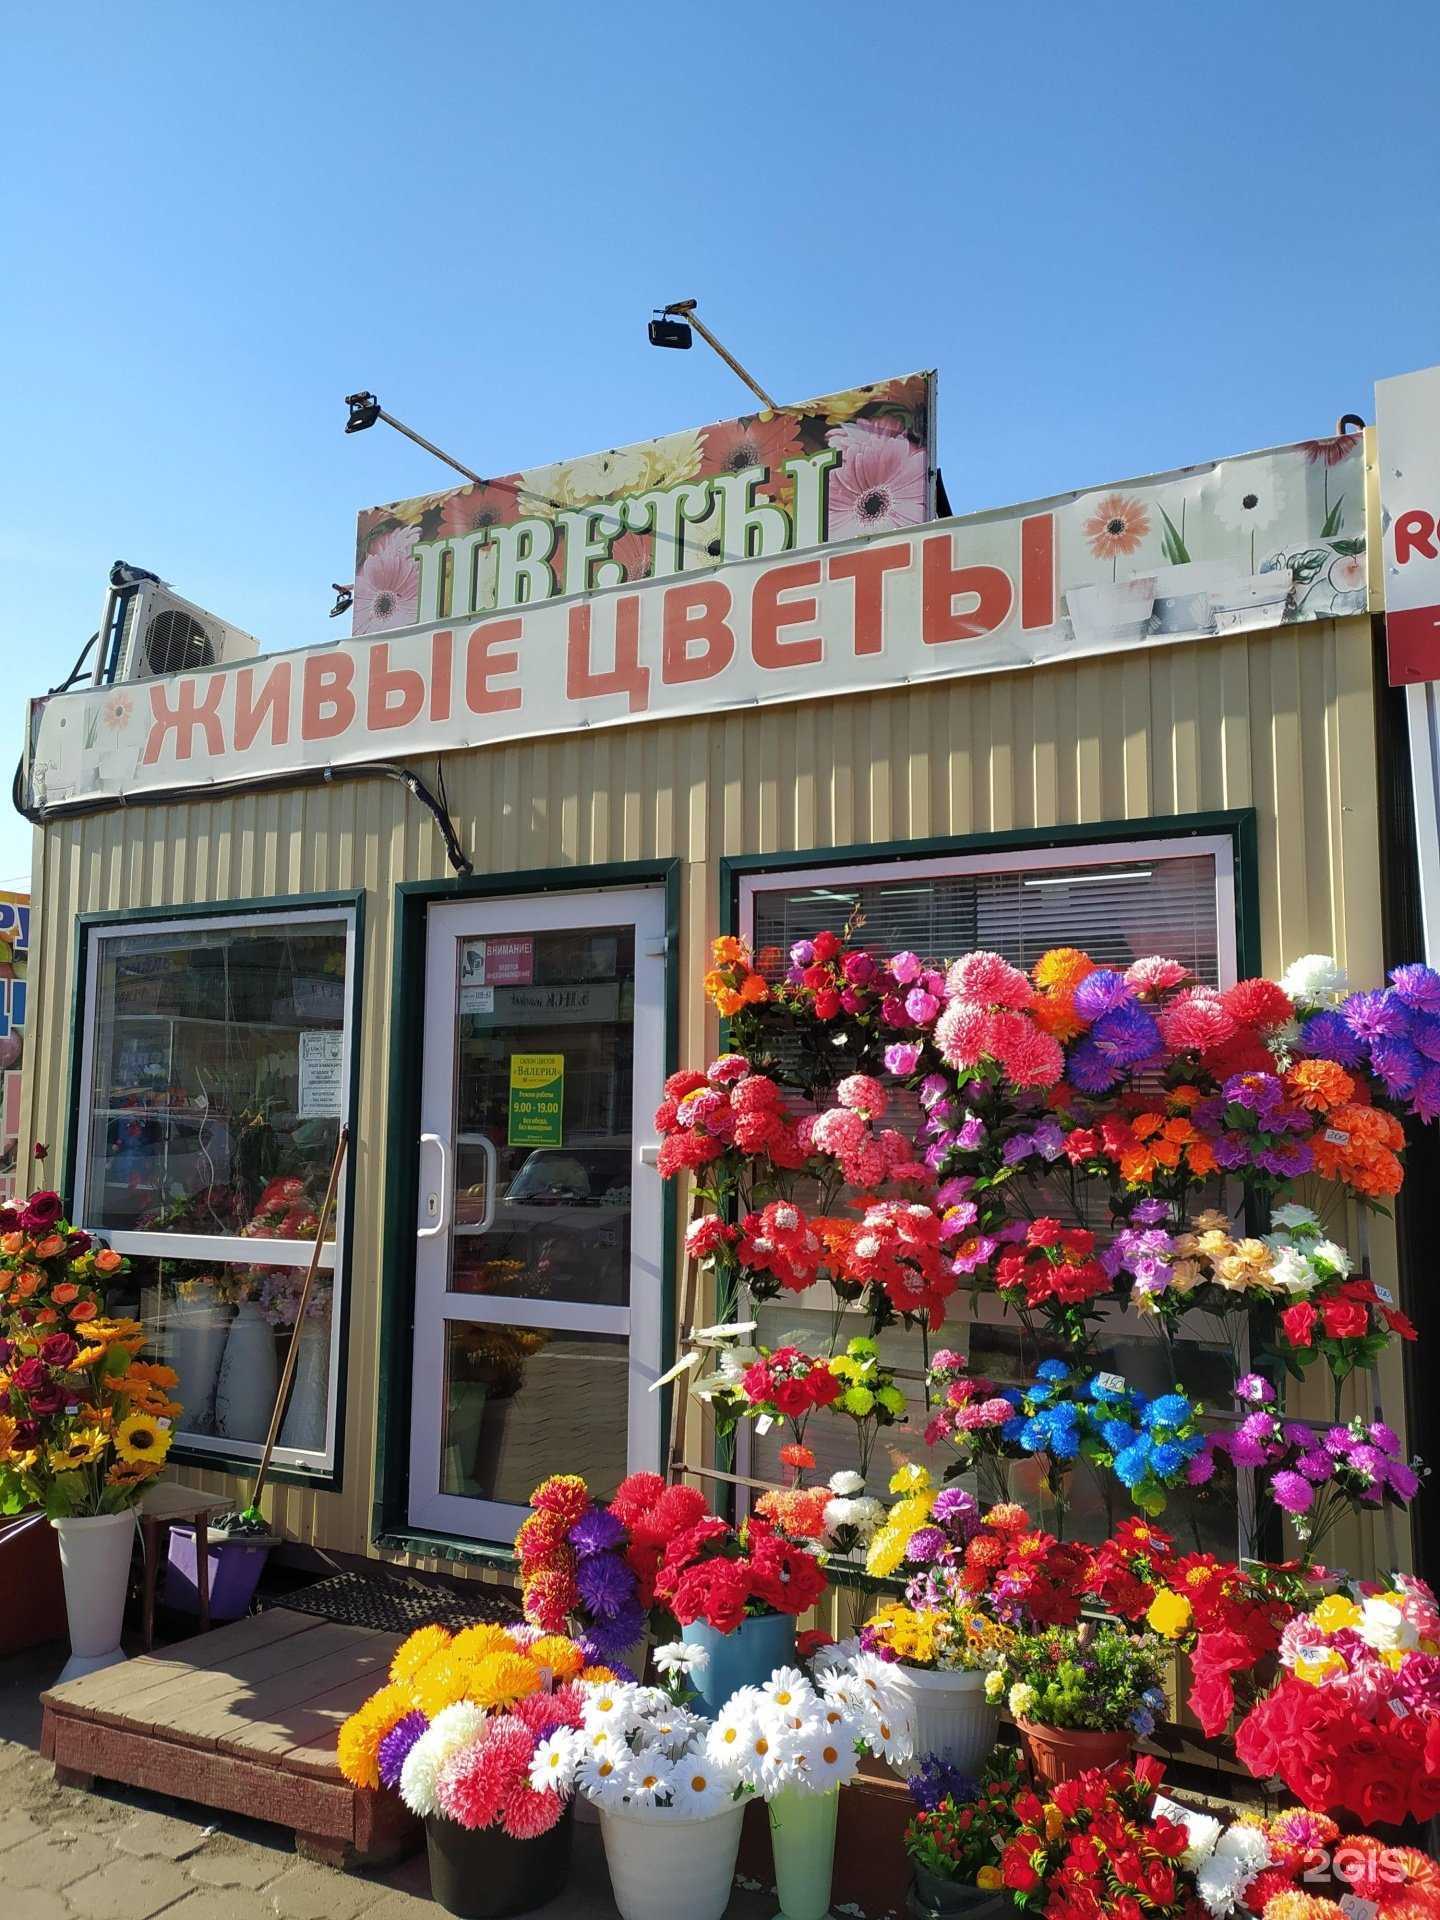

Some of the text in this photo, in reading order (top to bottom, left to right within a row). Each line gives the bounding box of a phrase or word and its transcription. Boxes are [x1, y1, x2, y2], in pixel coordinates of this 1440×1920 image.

[412, 448, 843, 624] ЦВЕТЫ
[1395, 511, 1440, 563] R
[143, 513, 1055, 765] ЖИВЫЕ ЦВЕТЫ
